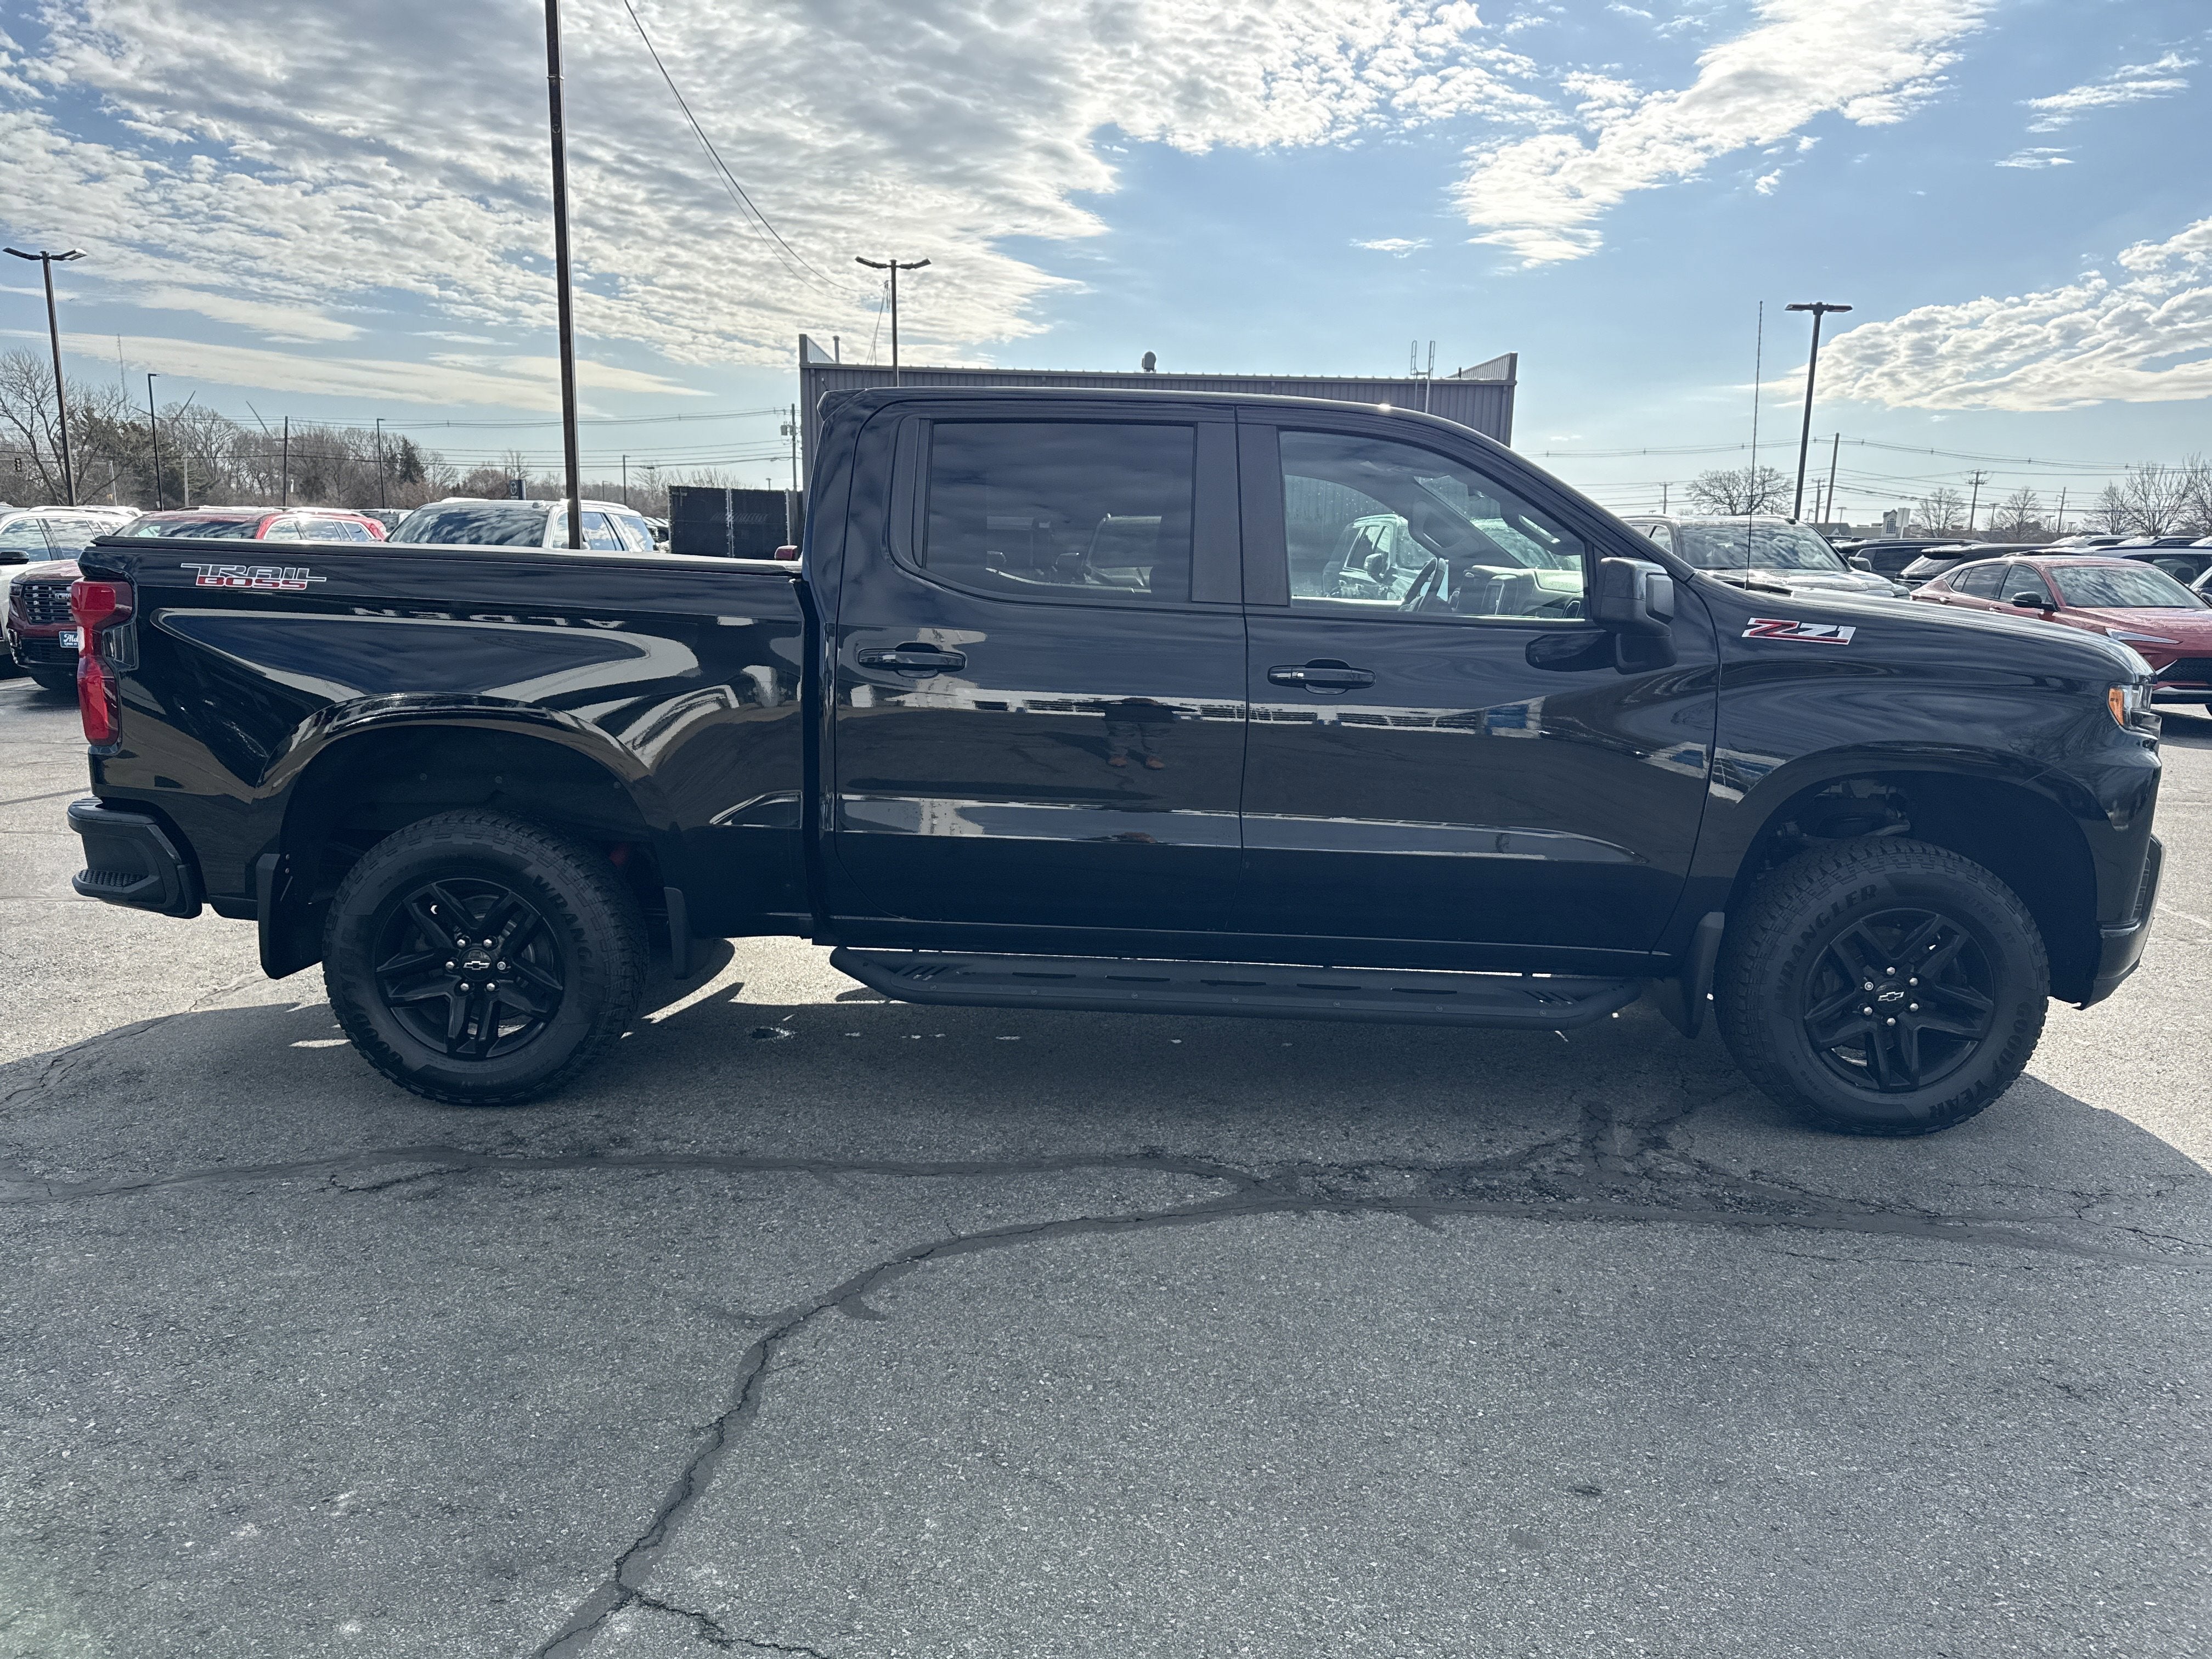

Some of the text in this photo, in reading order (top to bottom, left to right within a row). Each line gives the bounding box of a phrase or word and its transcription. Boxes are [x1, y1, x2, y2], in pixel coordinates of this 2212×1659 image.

[180, 563, 326, 582] TRAIL
[196, 574, 307, 590] BOSS
[1741, 617, 1857, 645] Z71
[1774, 883, 1878, 1002] WRANGLER
[1928, 1001, 2031, 1119] GOODYEAR
